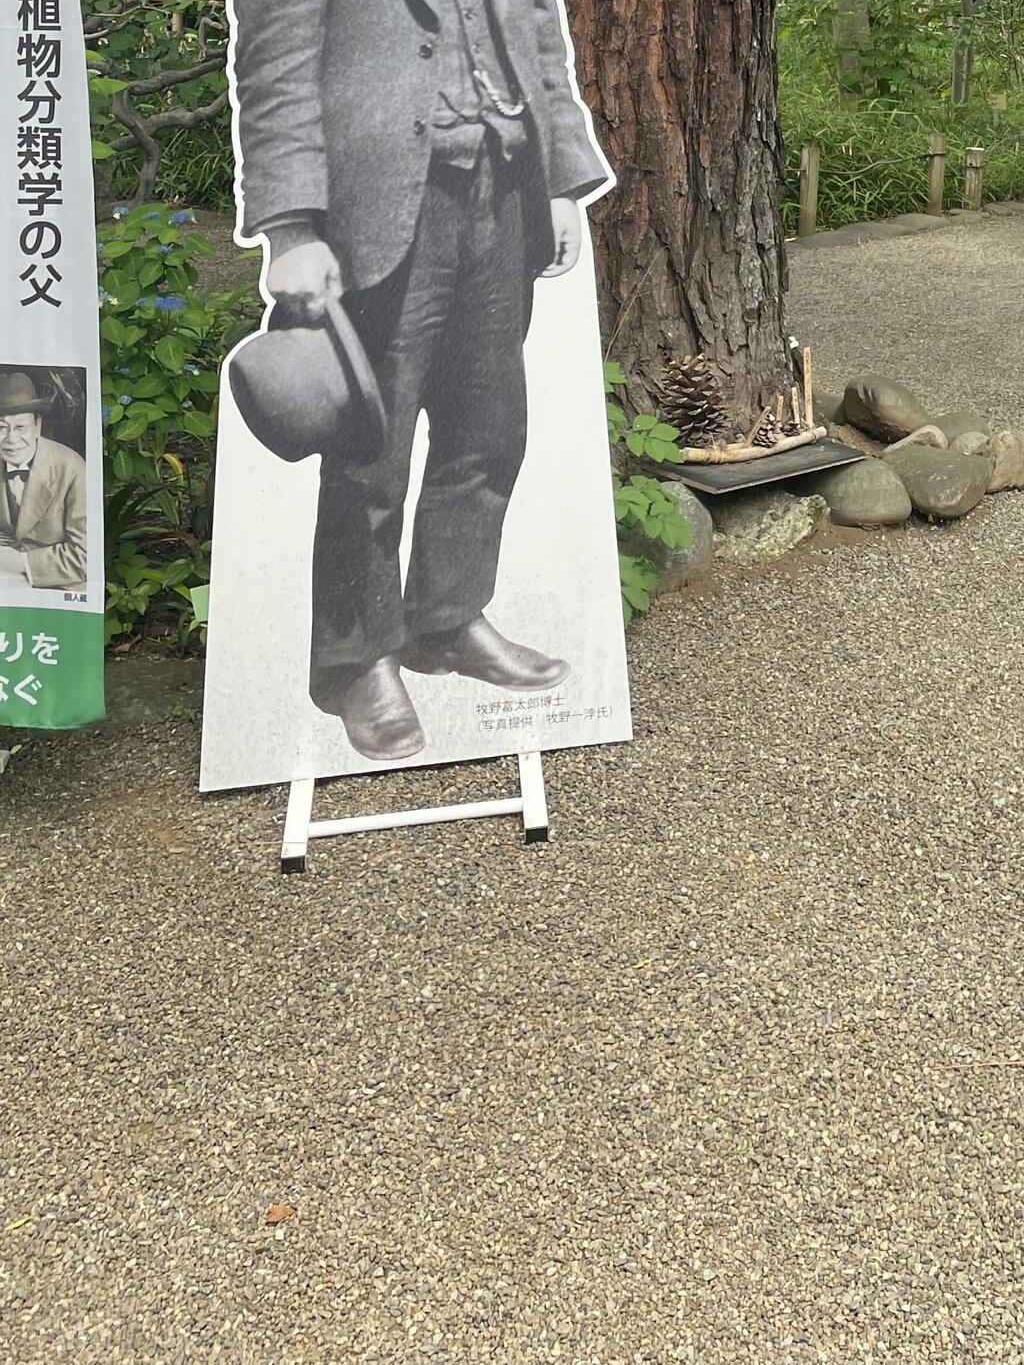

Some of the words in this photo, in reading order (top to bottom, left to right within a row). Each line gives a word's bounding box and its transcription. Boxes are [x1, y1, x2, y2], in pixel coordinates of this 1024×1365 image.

[475, 694, 566, 716] 牧野富太郎博士
